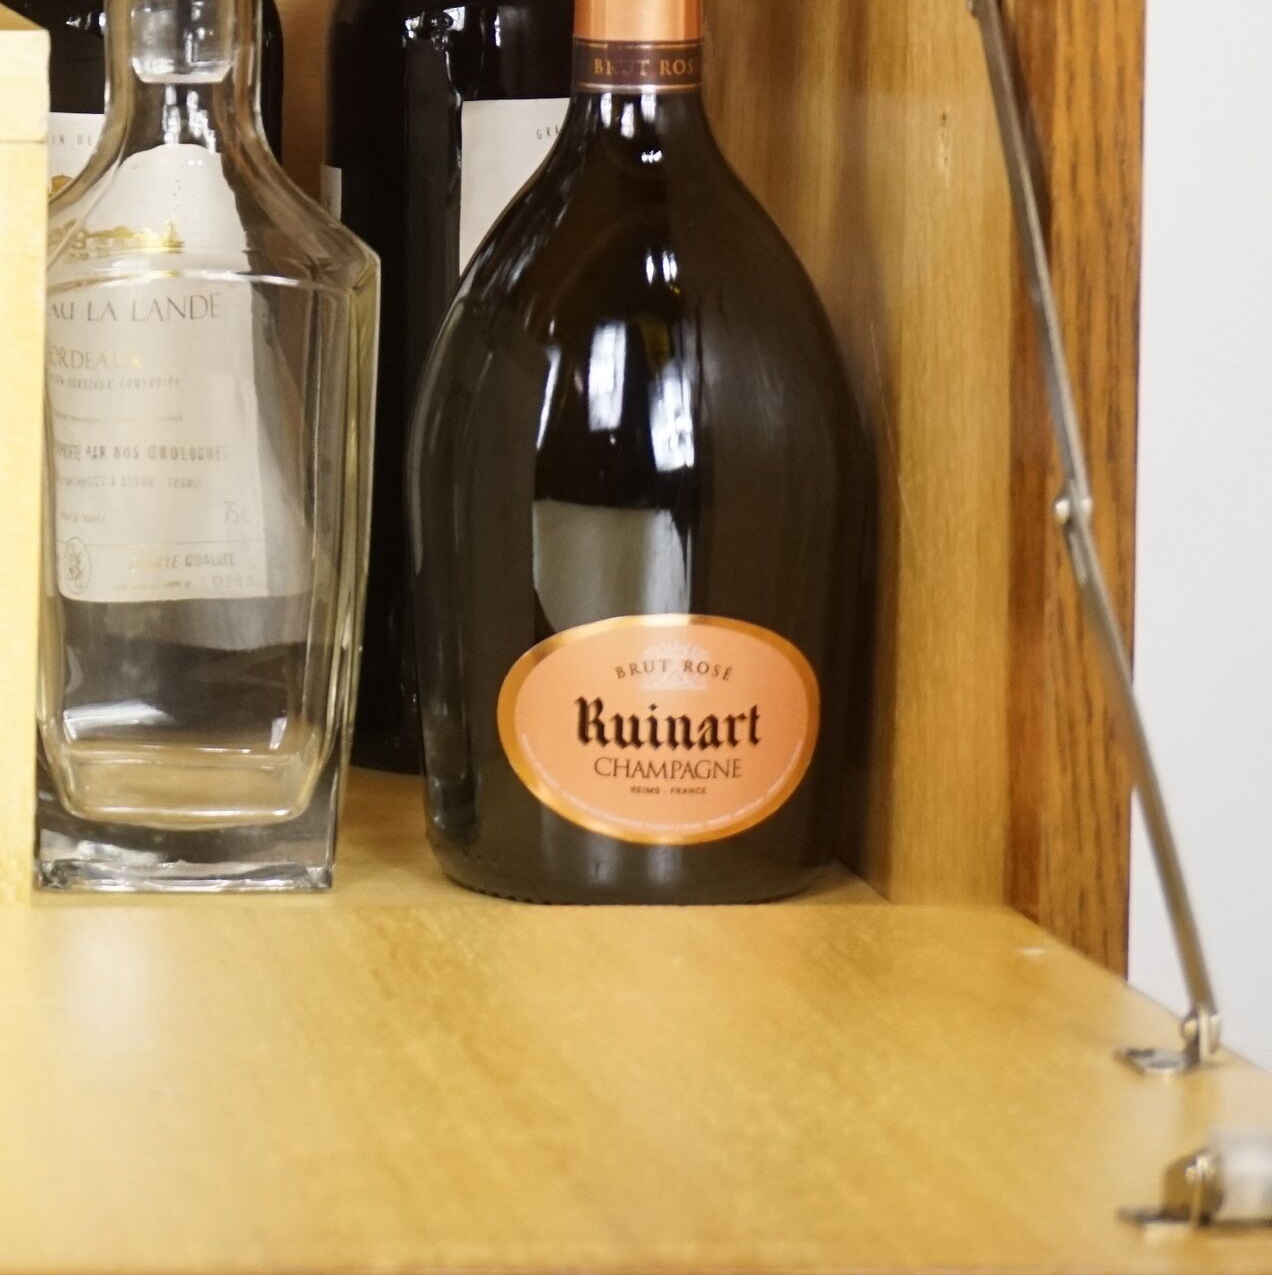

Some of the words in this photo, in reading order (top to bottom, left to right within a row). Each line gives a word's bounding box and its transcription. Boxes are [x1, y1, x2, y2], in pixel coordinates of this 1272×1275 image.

[87, 300, 117, 323] LA
[131, 292, 222, 323] LANDE
[615, 658, 669, 680] BRUT
[683, 659, 733, 681] ROSÉ
[574, 695, 761, 750] Ruinart
[594, 756, 742, 780] CHAMPAGNE
[630, 786, 660, 795] REIMS
[670, 786, 707, 795] FRANCE
